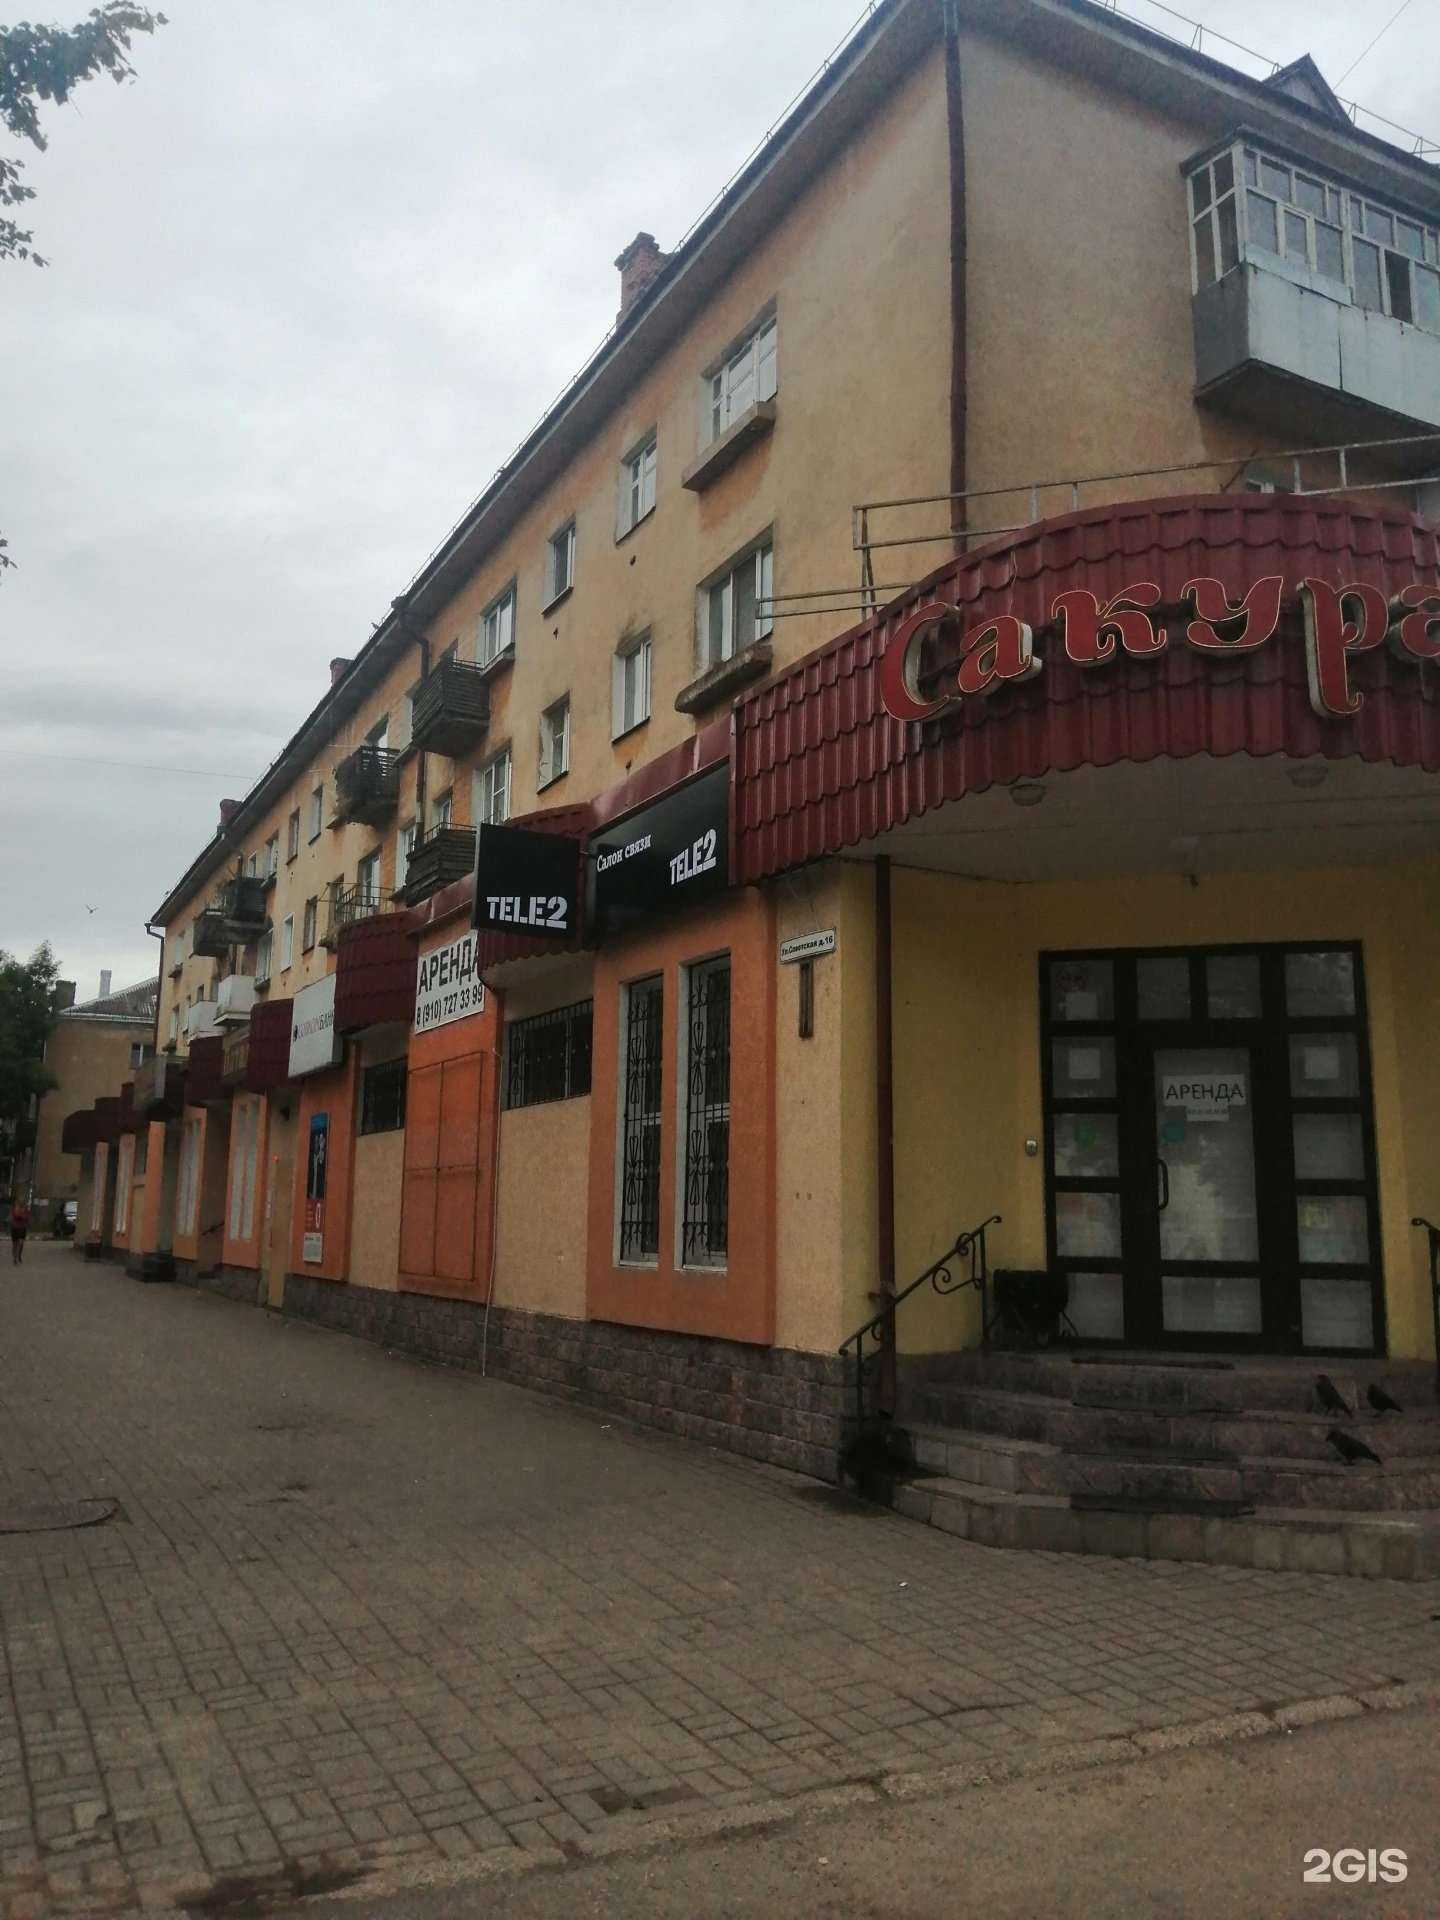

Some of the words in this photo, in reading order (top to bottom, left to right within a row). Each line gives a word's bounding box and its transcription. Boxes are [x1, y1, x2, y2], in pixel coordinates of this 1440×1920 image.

[597, 849, 623, 872] Салон
[624, 834, 651, 858] связи
[670, 828, 717, 885] TELE2
[486, 895, 568, 929] TELE2
[416, 1007, 422, 1026] 8
[422, 999, 442, 1027] (910)
[443, 992, 458, 1016] 727
[460, 988, 470, 1009] 33
[472, 983, 483, 1005] 99
[1166, 1083, 1244, 1102] АРЕНДА
